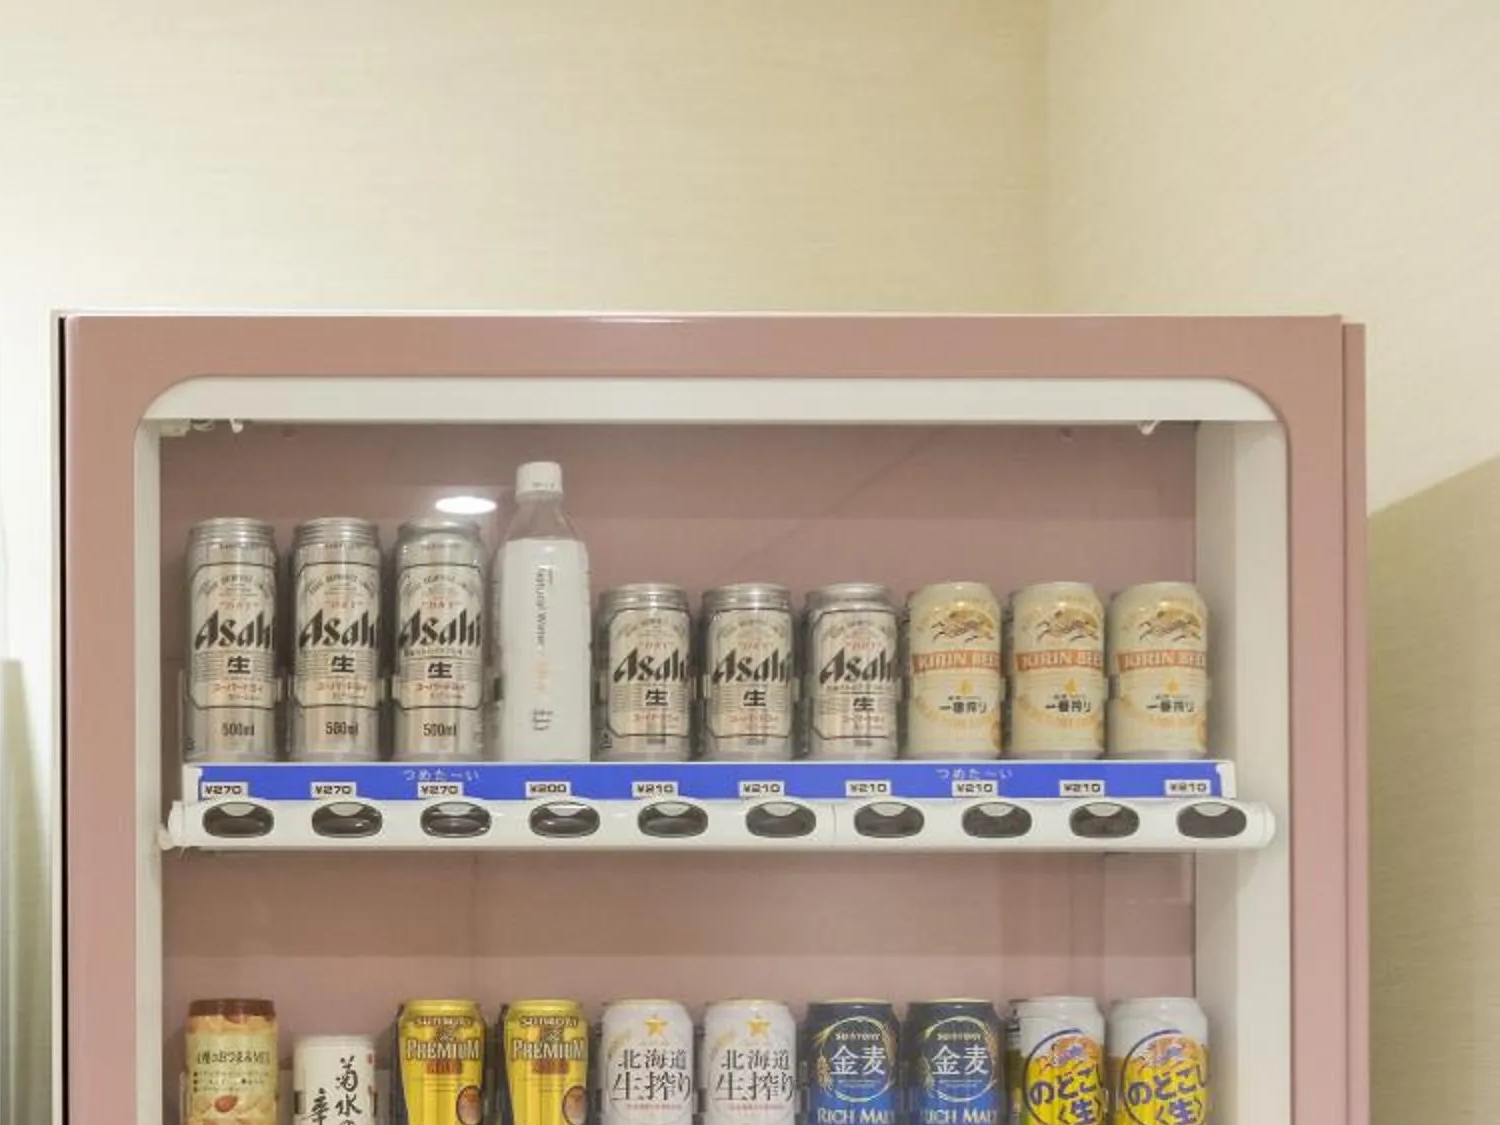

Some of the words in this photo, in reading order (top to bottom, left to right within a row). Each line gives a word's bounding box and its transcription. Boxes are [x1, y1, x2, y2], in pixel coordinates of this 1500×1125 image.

[227, 656, 251, 674] 生
[331, 655, 355, 673] 生
[917, 651, 968, 669] KIRIN
[1021, 651, 1074, 668] KIRIN
[1123, 651, 1176, 668] KIRIN
[428, 662, 453, 679] 生
[644, 689, 669, 707] 生
[743, 689, 767, 707] 生
[852, 695, 876, 711] 生
[938, 700, 987, 714] 一番搾り
[1044, 699, 1092, 714] 一番搾り
[1146, 700, 1194, 714] 一番搾り
[406, 1037, 480, 1060] PREMIUM
[511, 1037, 583, 1060] PREMIUM
[617, 1048, 687, 1070] 北海道
[720, 1048, 790, 1070] 北海道
[829, 1044, 886, 1075] 金麦
[931, 1044, 990, 1075] 金麦
[611, 1071, 691, 1101] 生搾り
[715, 1071, 795, 1101] 生搾り
[817, 1107, 854, 1124] RICH
